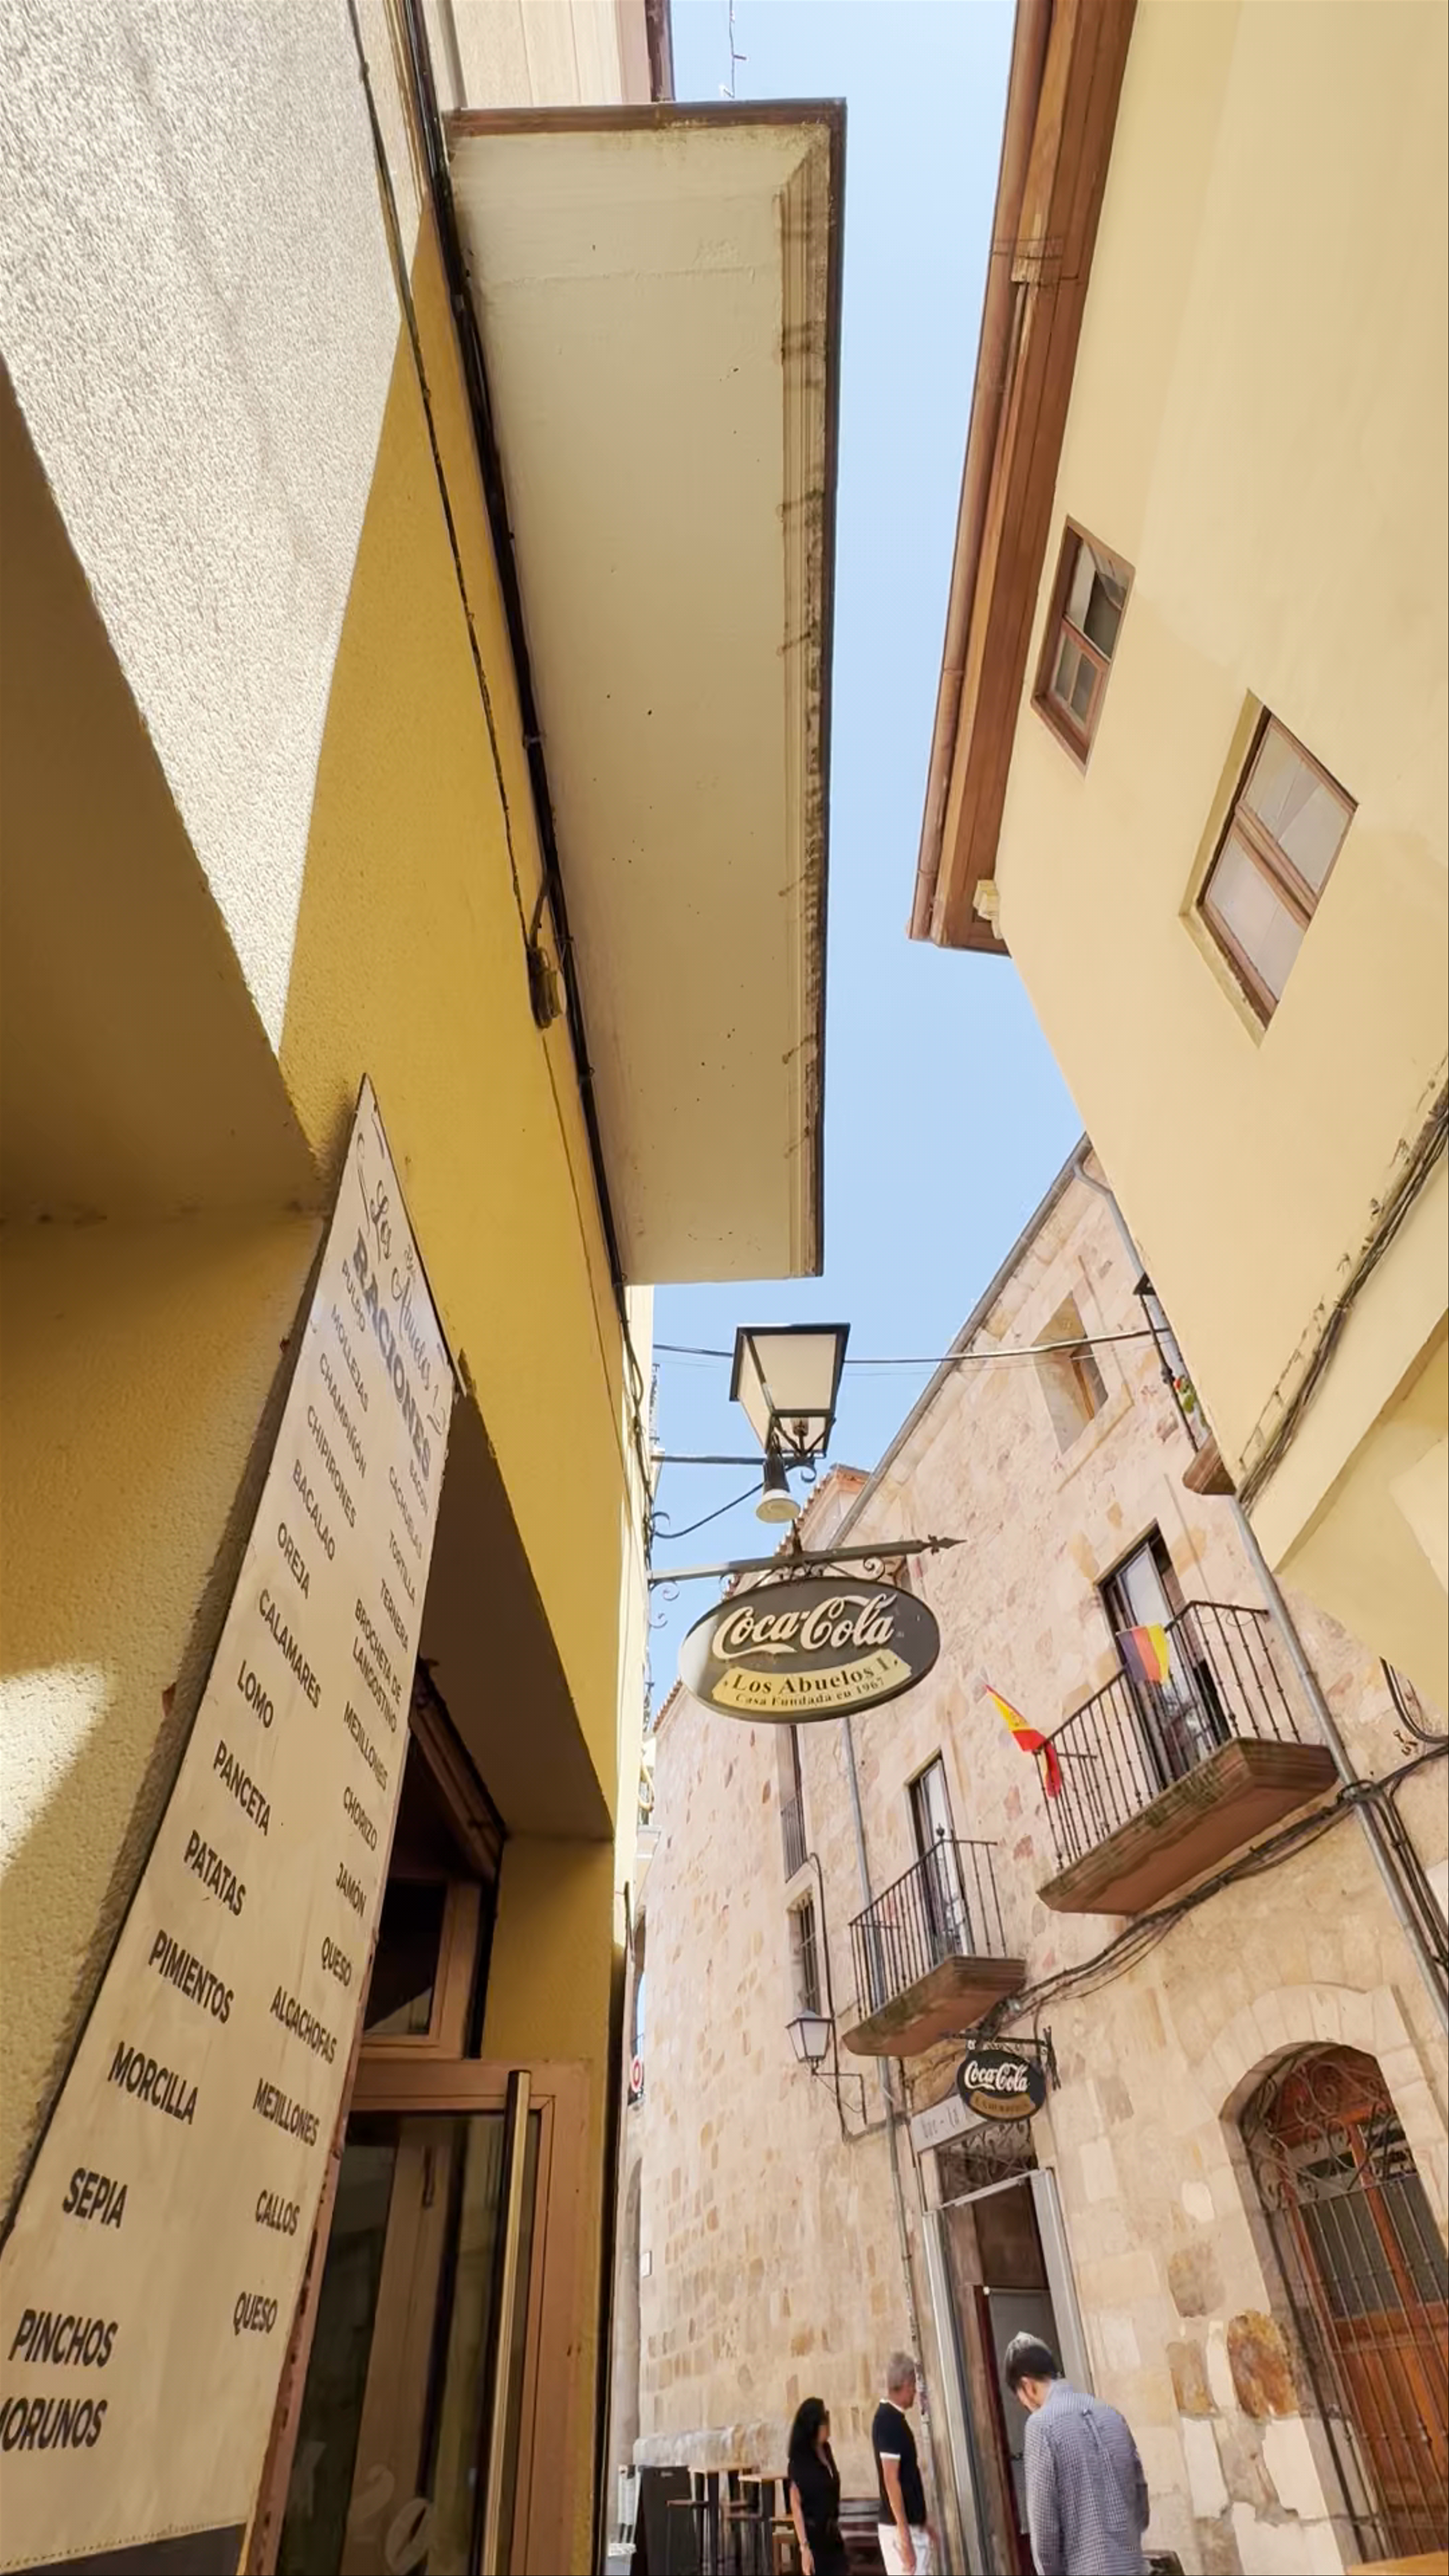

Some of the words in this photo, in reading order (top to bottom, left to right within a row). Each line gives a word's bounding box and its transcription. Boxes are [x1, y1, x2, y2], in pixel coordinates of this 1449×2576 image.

[342, 1258, 365, 1333] PULPO
[331, 1303, 369, 1413] MOLLEJAS
[353, 1226, 431, 1481] RACIONES
[320, 1353, 366, 1479] CHAMPIÑÓN
[308, 1405, 357, 1528] CHIPIRONES
[293, 1458, 336, 1561] BACALAO
[277, 1522, 310, 1599] OREJA
[389, 1528, 415, 1607] TORTILLA
[259, 1588, 321, 1709] CALAMARES
[355, 1598, 392, 1686] BROCHETA
[391, 1674, 402, 1706] DE
[380, 1578, 409, 1653] TERNERA
[711, 1593, 897, 1661] Coca-Cola
[237, 1659, 274, 1729] LOMO
[732, 1673, 772, 1695] Los
[778, 1666, 875, 1695] Abuelos
[735, 1694, 767, 1706] Casa
[771, 1693, 831, 1707] Fundada
[835, 1690, 852, 1701] en
[856, 1676, 886, 1695] 1967
[343, 1700, 388, 1792] MEJILLONES
[213, 1739, 271, 1836] PANCETA
[343, 1786, 377, 1852] CHORIZO
[183, 1829, 246, 1916] PATATAS
[336, 1862, 367, 1918] JAMÓN
[148, 1929, 235, 2024] PIMIENTOS
[321, 1936, 352, 1987] QUESO
[269, 1985, 337, 2065] ALCACHOFAS
[107, 2040, 198, 2125] MORCILLA
[252, 2077, 320, 2147] MEJILLONES
[964, 2060, 1030, 2092] Coca-Cola
[62, 2167, 128, 2229] SEPIA
[254, 2190, 300, 2236] CALLOS
[7, 2308, 118, 2368] PINCHOS
[232, 2291, 278, 2336] QUESO
